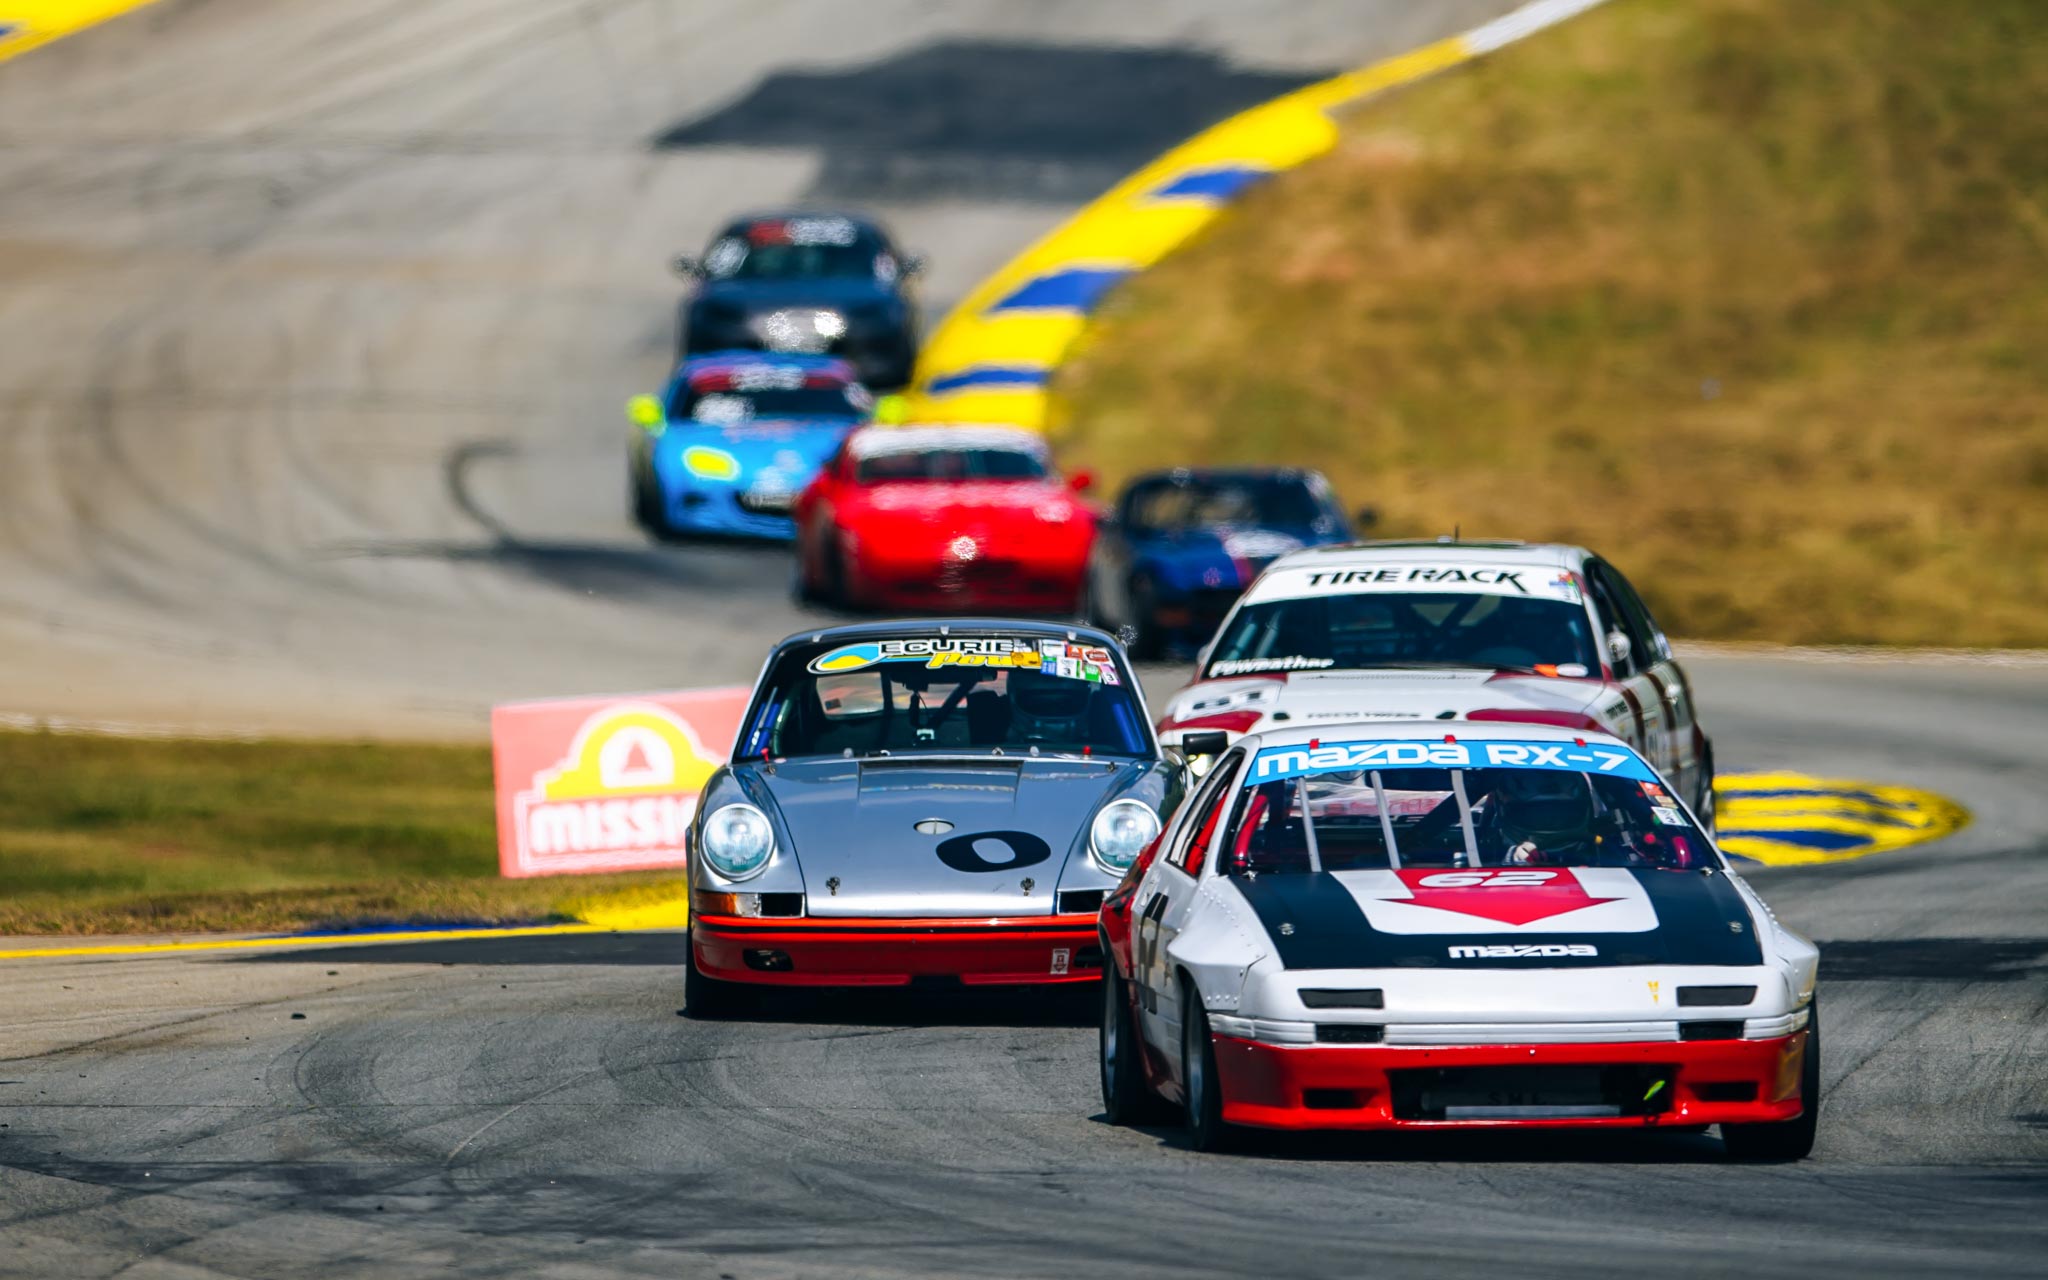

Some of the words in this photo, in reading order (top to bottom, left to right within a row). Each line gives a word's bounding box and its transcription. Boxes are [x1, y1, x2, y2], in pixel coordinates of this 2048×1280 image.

[1307, 568, 1401, 586] TIRE
[1407, 569, 1529, 593] RACK
[878, 638, 1013, 656] ECURIE
[1486, 745, 1630, 771] RX-7
[1418, 870, 1558, 888] 62
